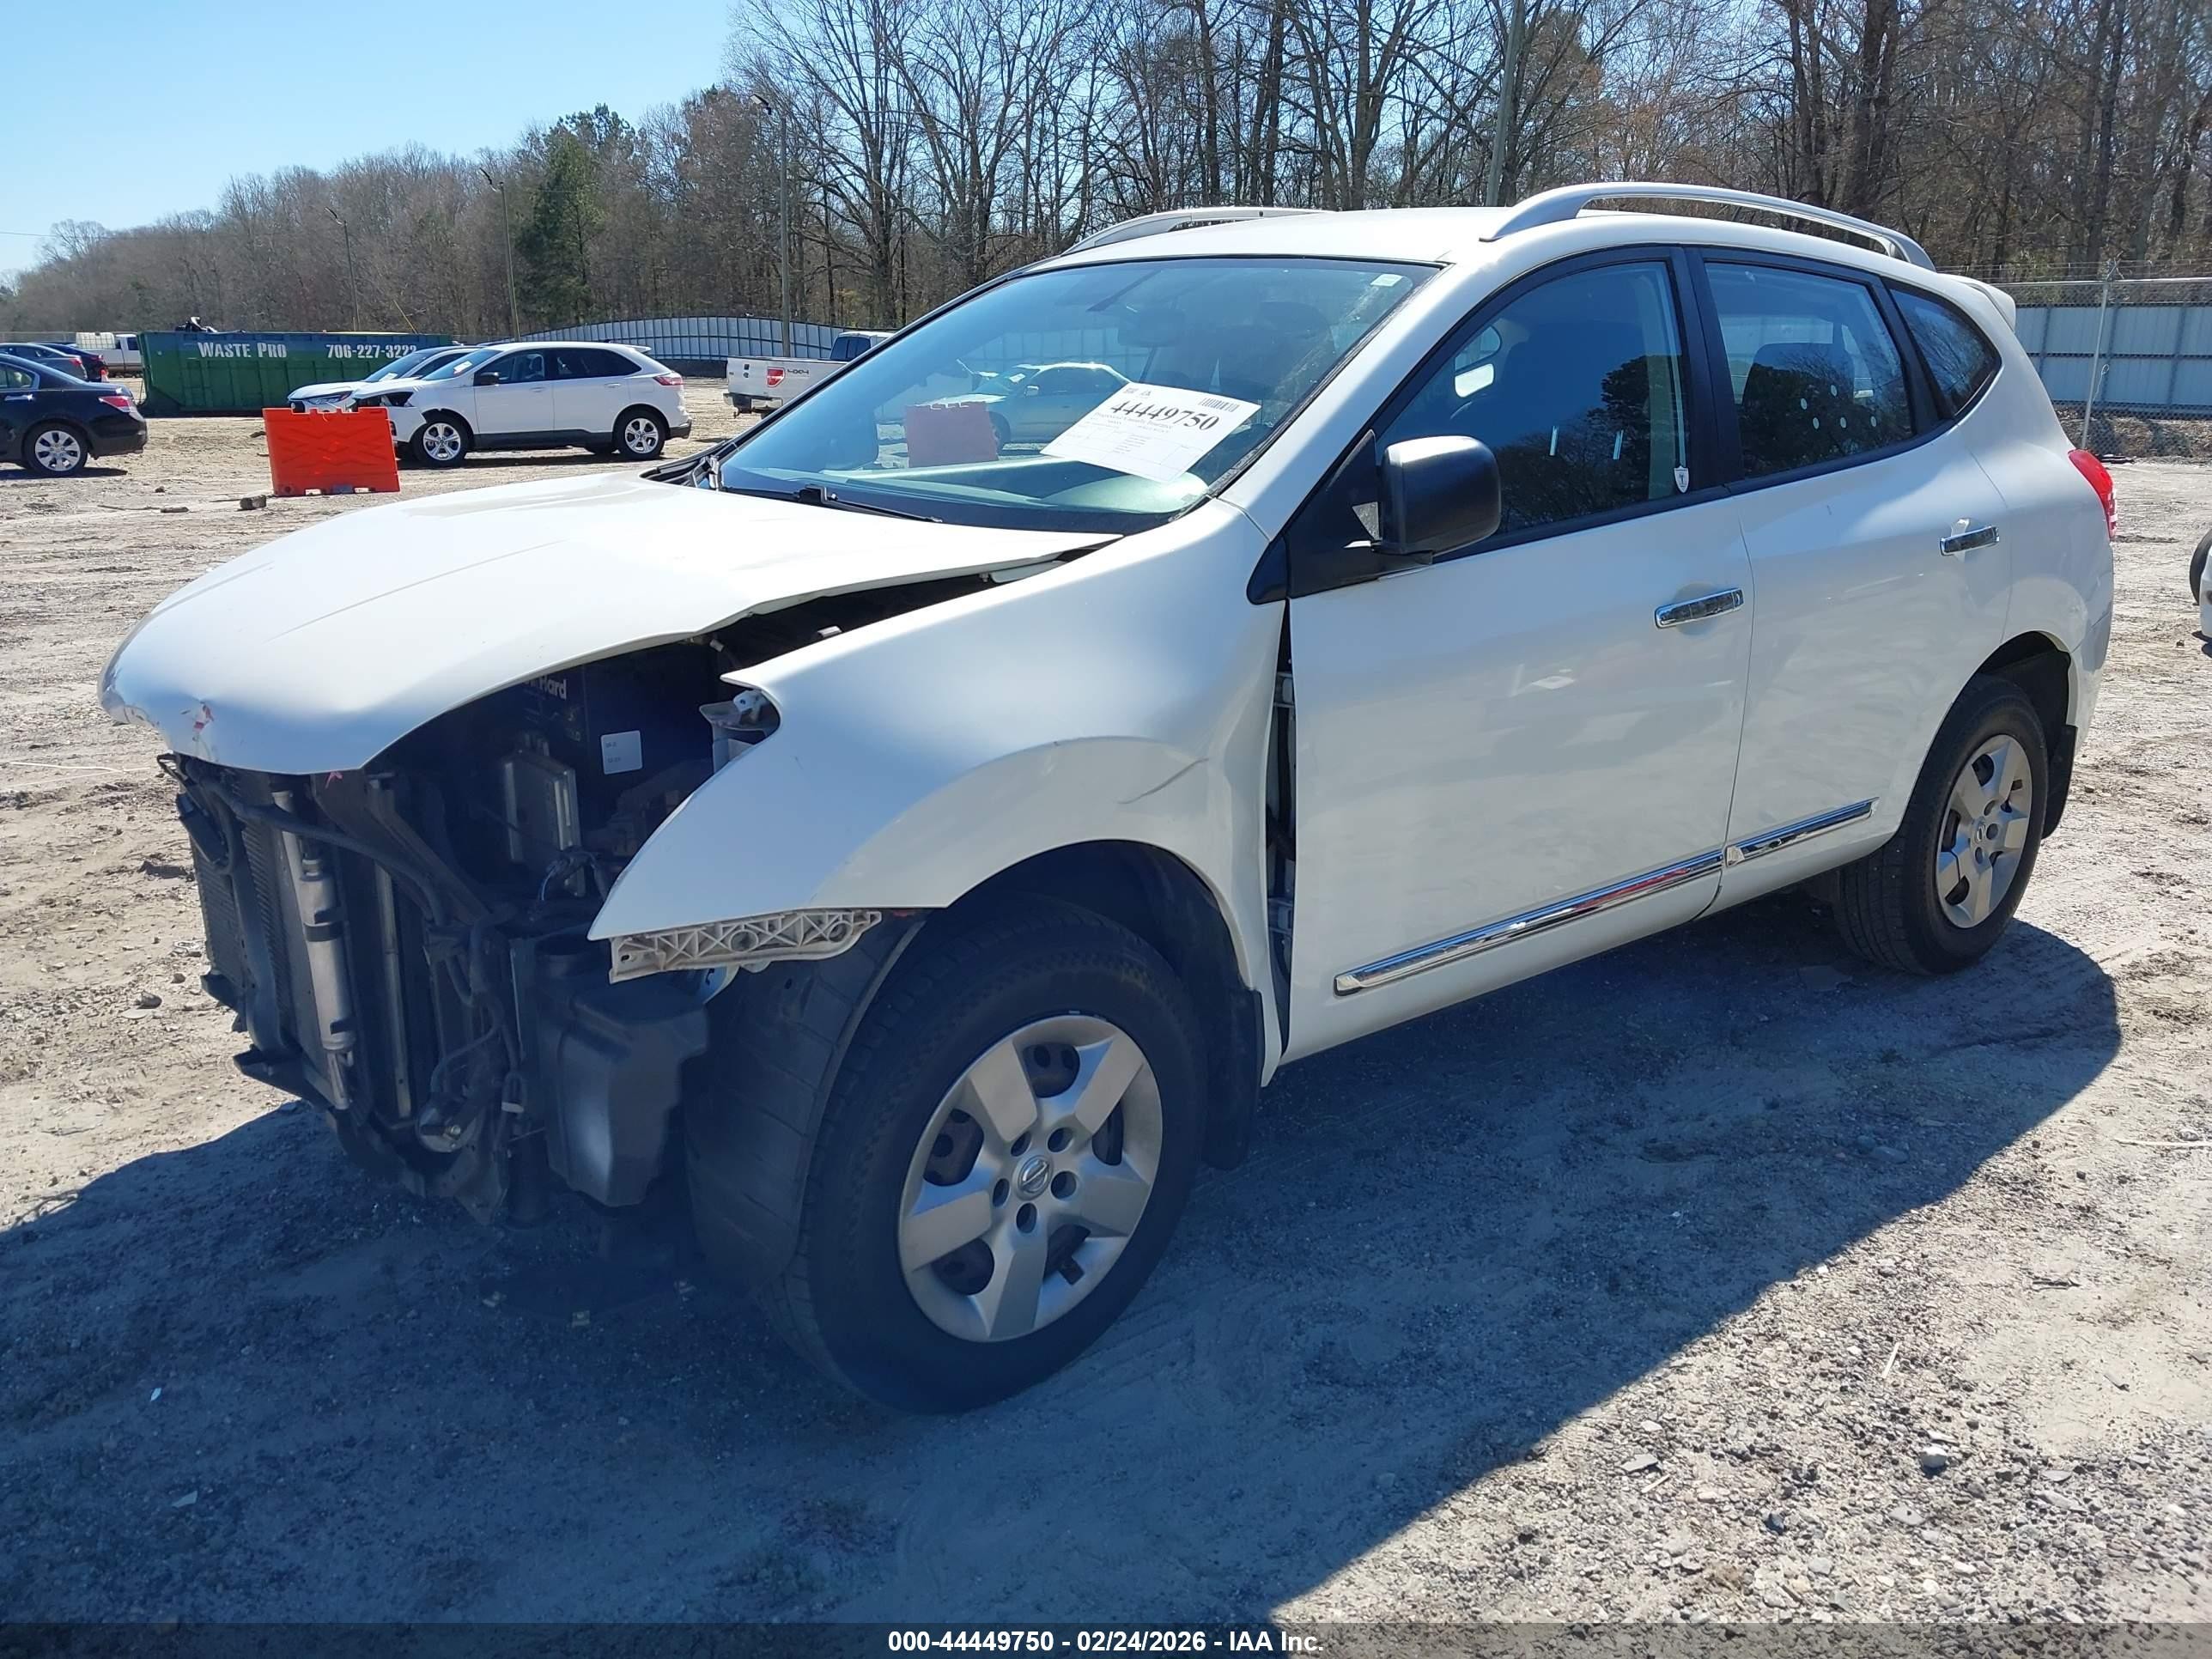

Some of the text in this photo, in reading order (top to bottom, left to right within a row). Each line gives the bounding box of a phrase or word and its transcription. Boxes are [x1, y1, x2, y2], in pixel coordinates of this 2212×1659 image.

[198, 342, 287, 358] WASTE PRO
[1110, 400, 1219, 430] 44449750
